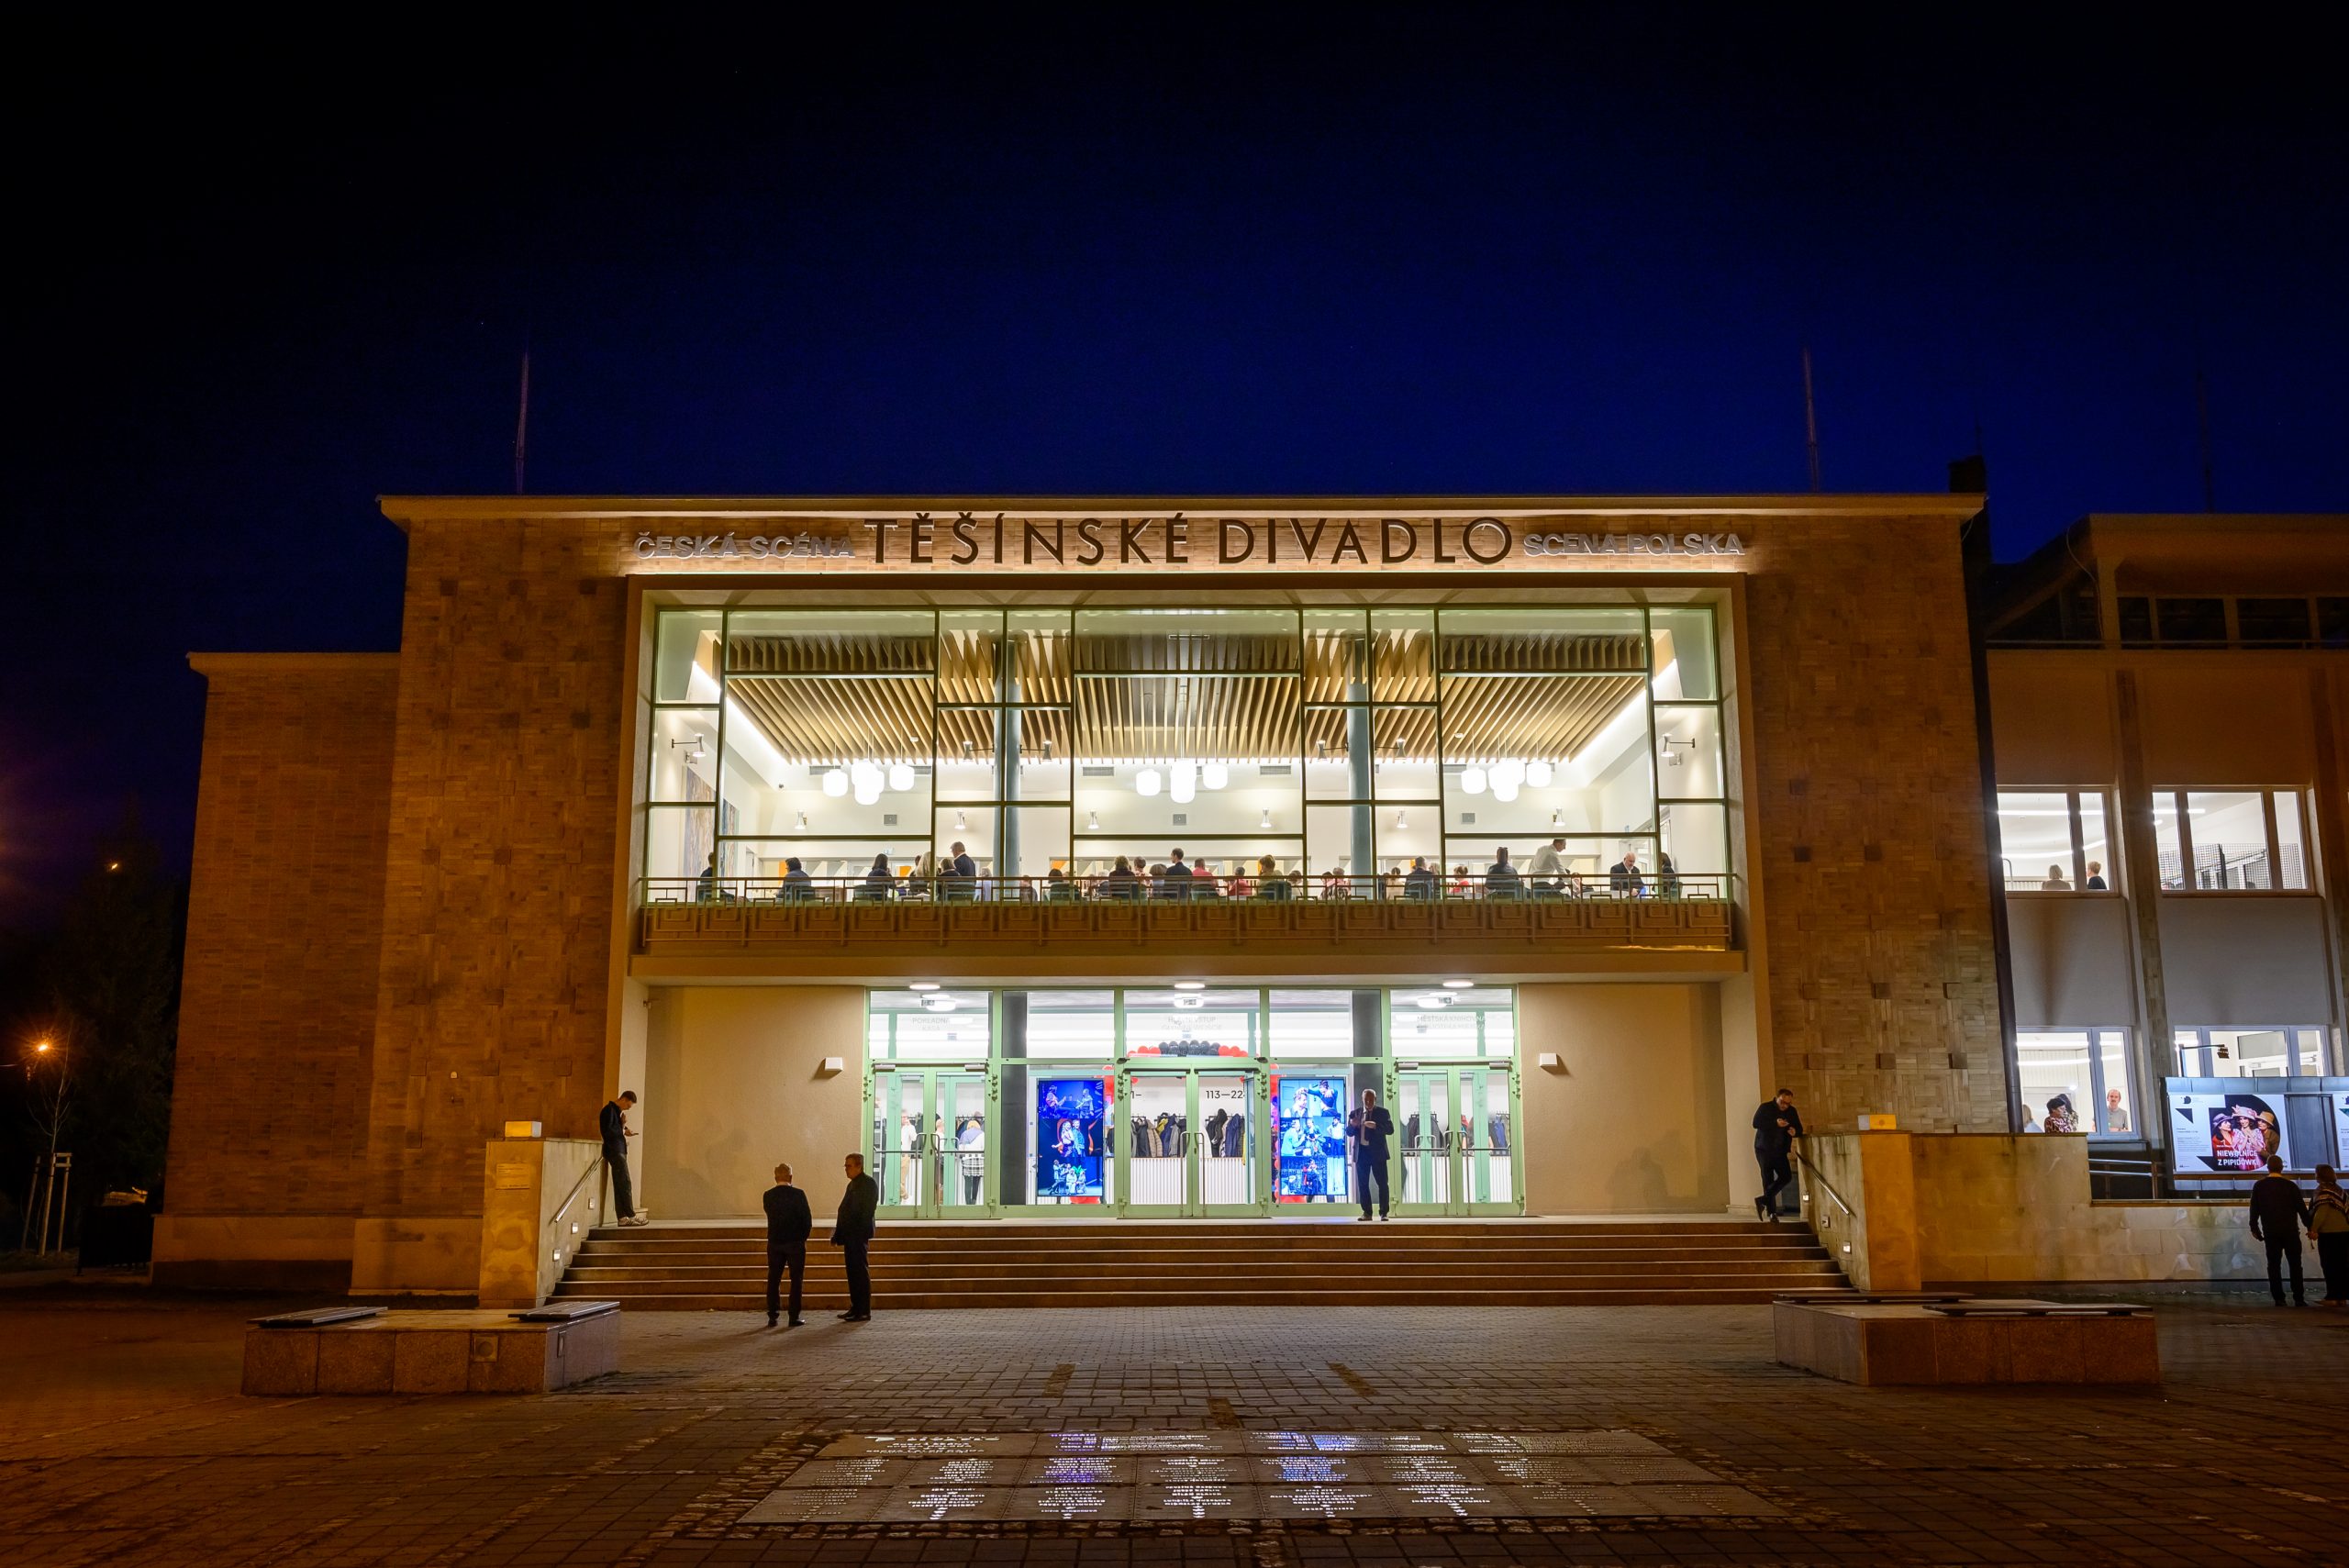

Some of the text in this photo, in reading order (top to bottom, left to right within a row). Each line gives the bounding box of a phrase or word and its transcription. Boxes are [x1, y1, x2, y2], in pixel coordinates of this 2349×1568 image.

[633, 531, 856, 560] ČESKÁ SCÉNA
[864, 512, 1512, 565] TĚŠÍNSKÉ DIVADLO
[1523, 533, 1746, 557] SCENA POLSKA
